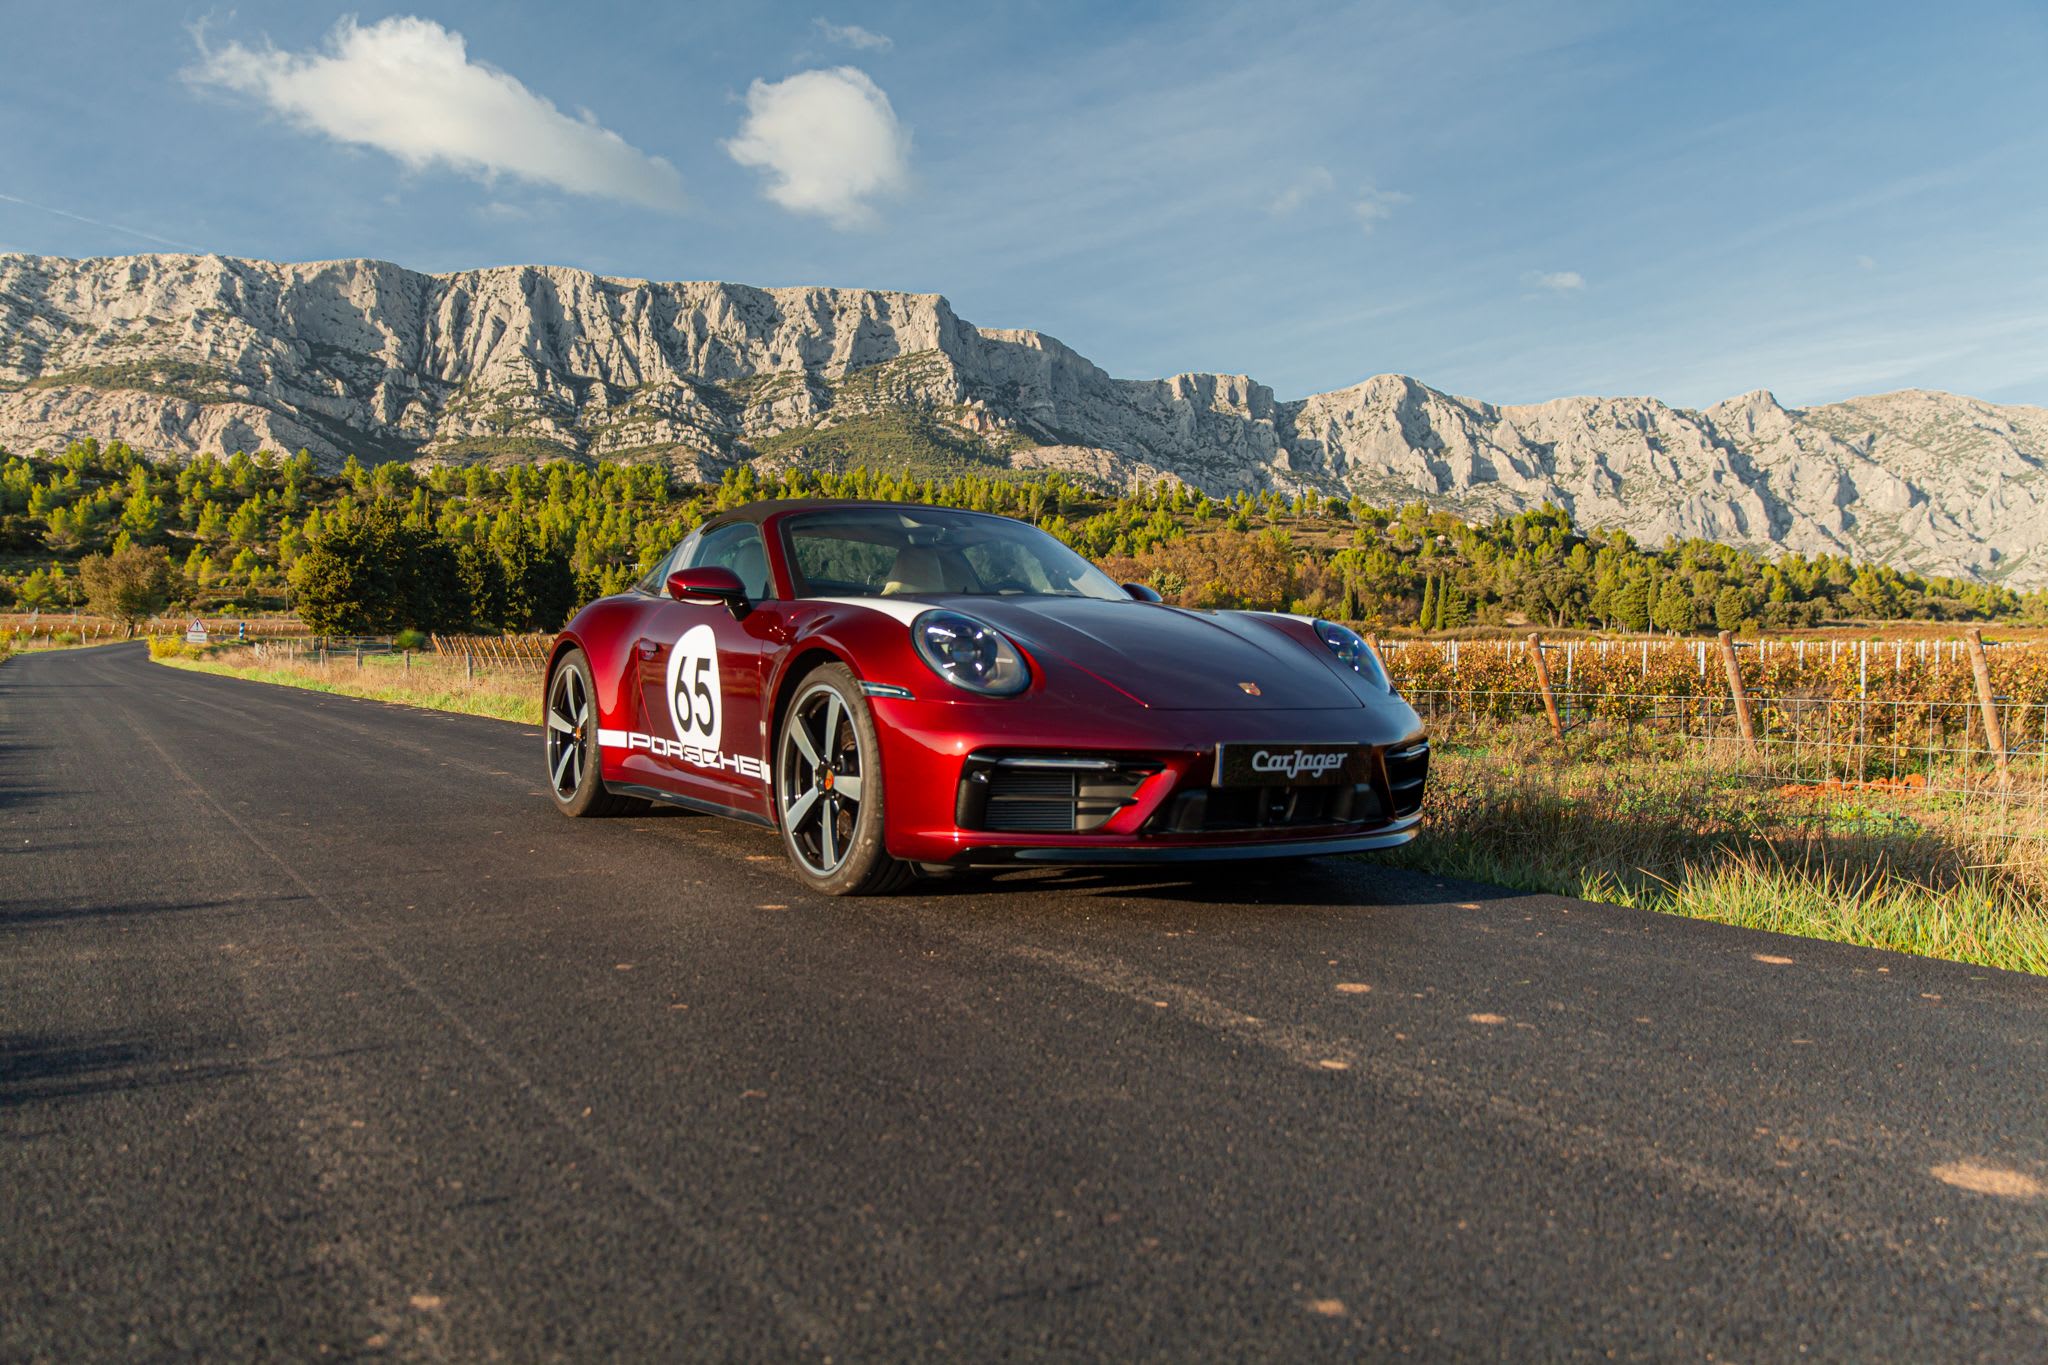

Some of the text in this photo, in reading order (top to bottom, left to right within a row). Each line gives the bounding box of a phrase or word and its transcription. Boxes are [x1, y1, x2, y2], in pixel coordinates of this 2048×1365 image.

[674, 656, 714, 737] 65
[628, 732, 762, 779] PORSCHE
[1251, 750, 1348, 779] CarJager
